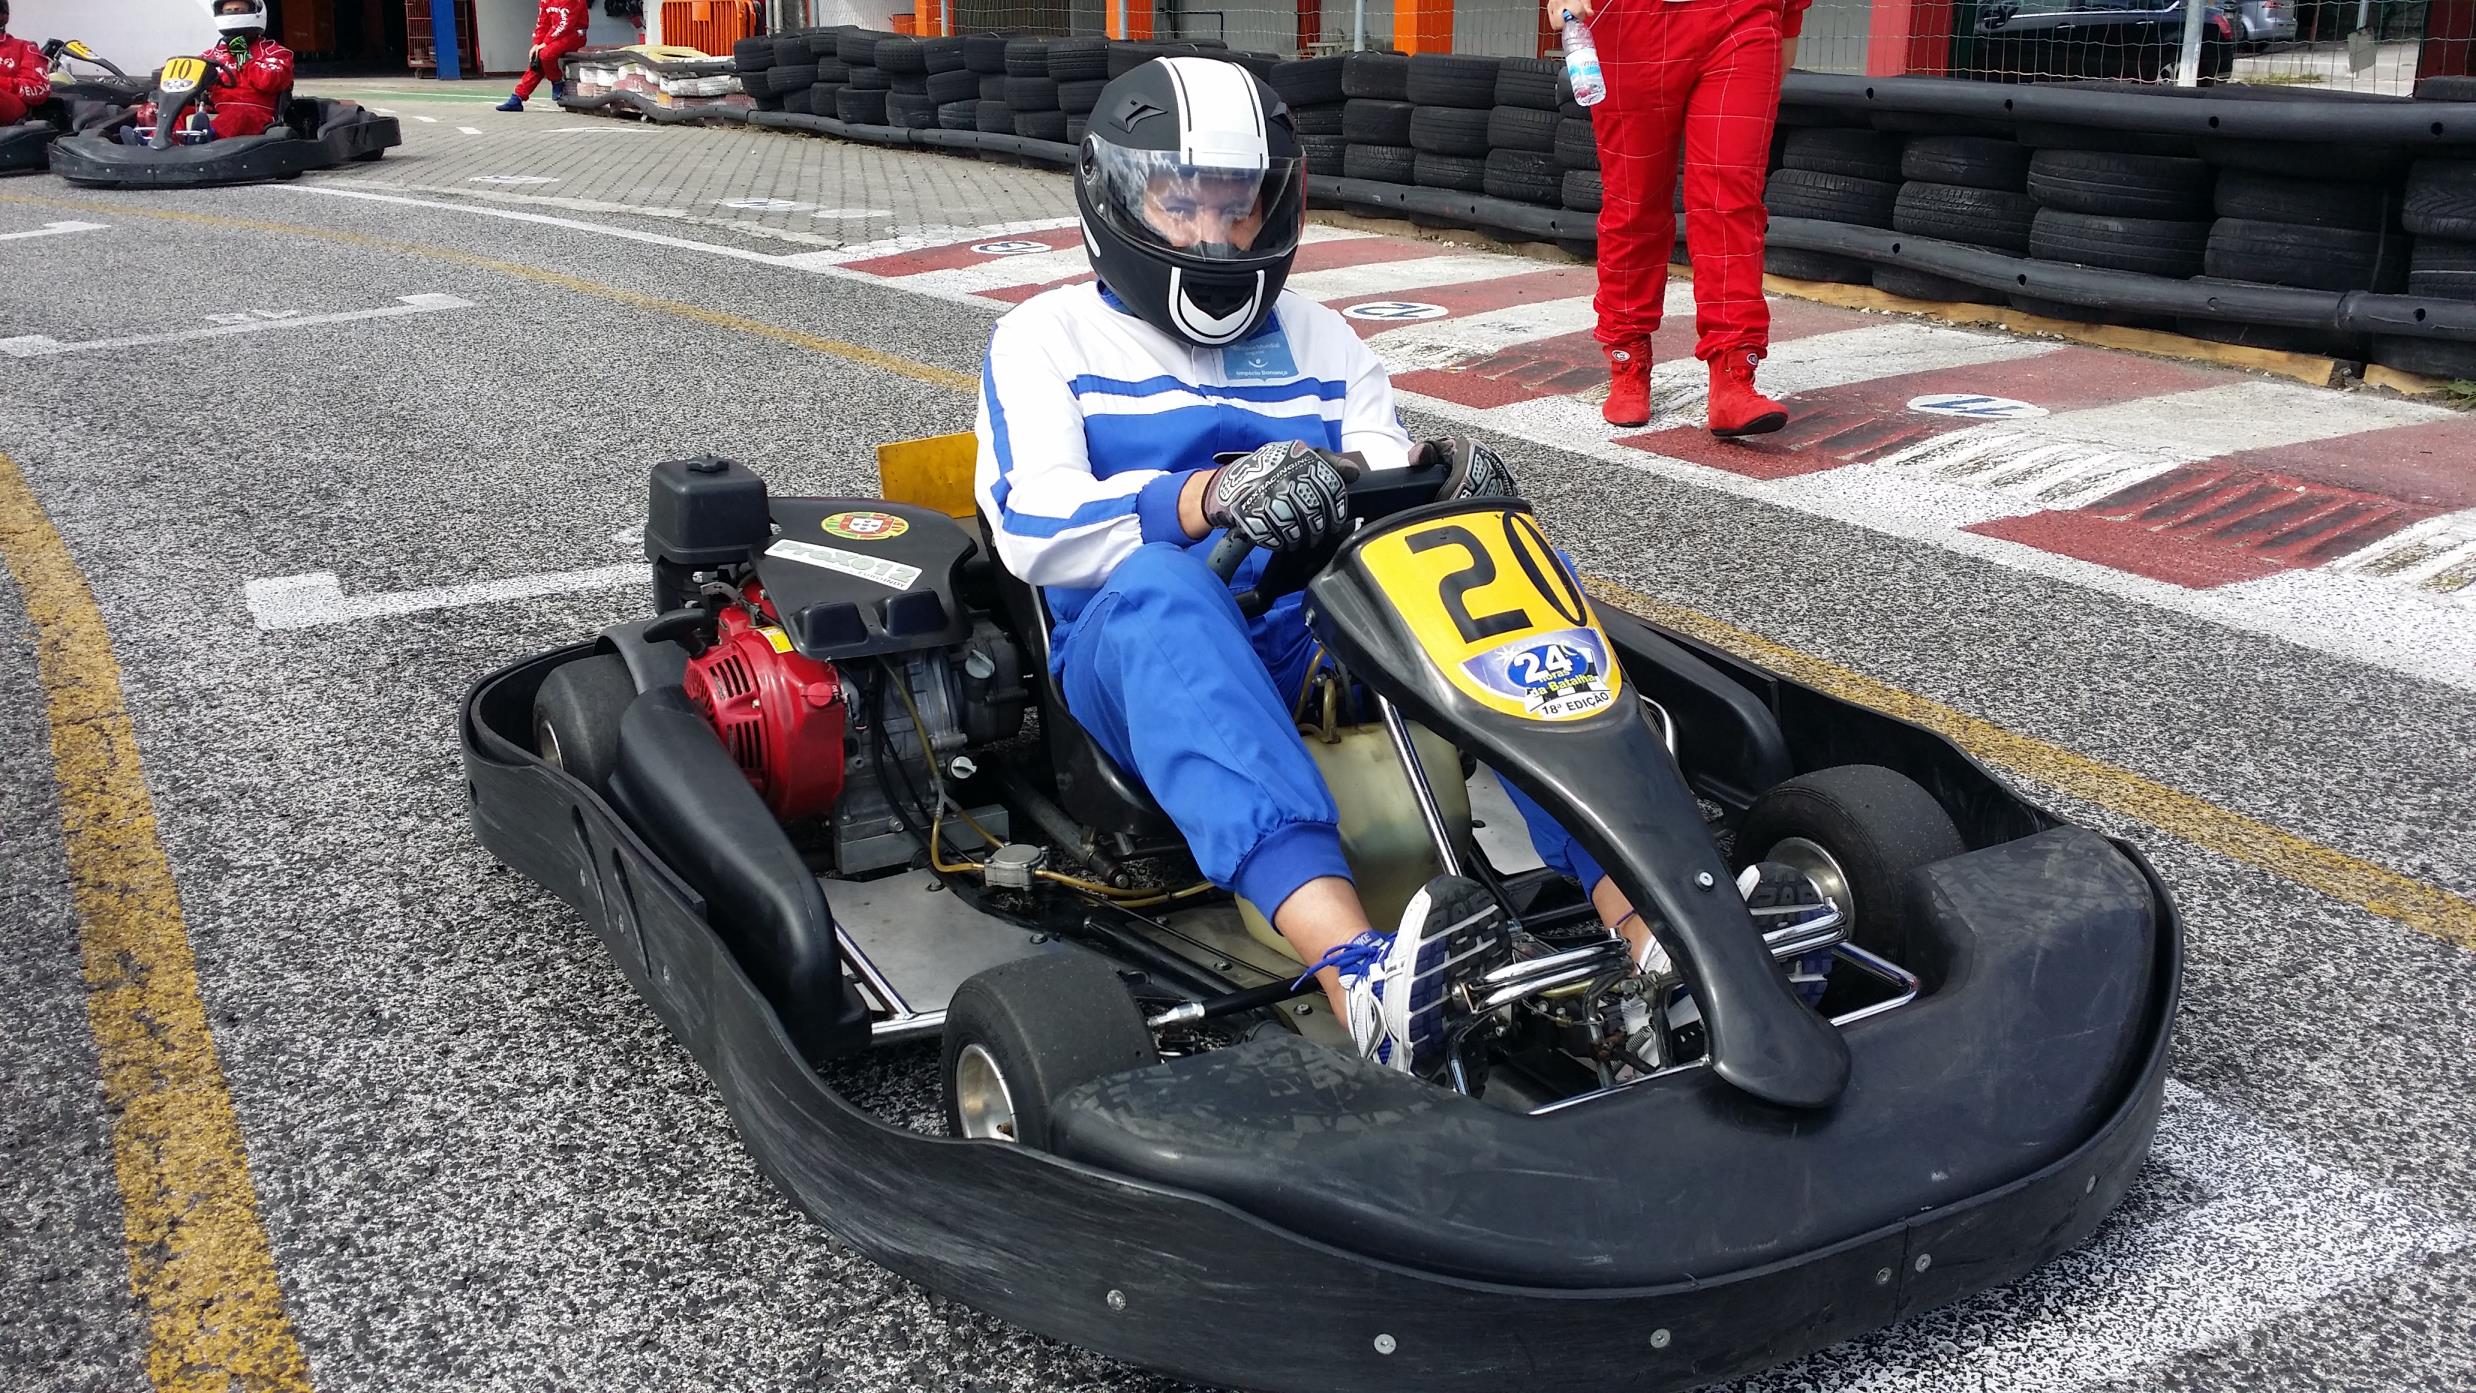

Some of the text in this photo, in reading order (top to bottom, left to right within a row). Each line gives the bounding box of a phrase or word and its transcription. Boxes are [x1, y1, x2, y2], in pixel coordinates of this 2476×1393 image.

[169, 60, 192, 79] 10
[1405, 511, 1587, 644] 20
[1513, 645, 1573, 683] 24
[1548, 674, 1595, 691] Batalha
[1541, 691, 1609, 715] 18ª EDIÇÃO
